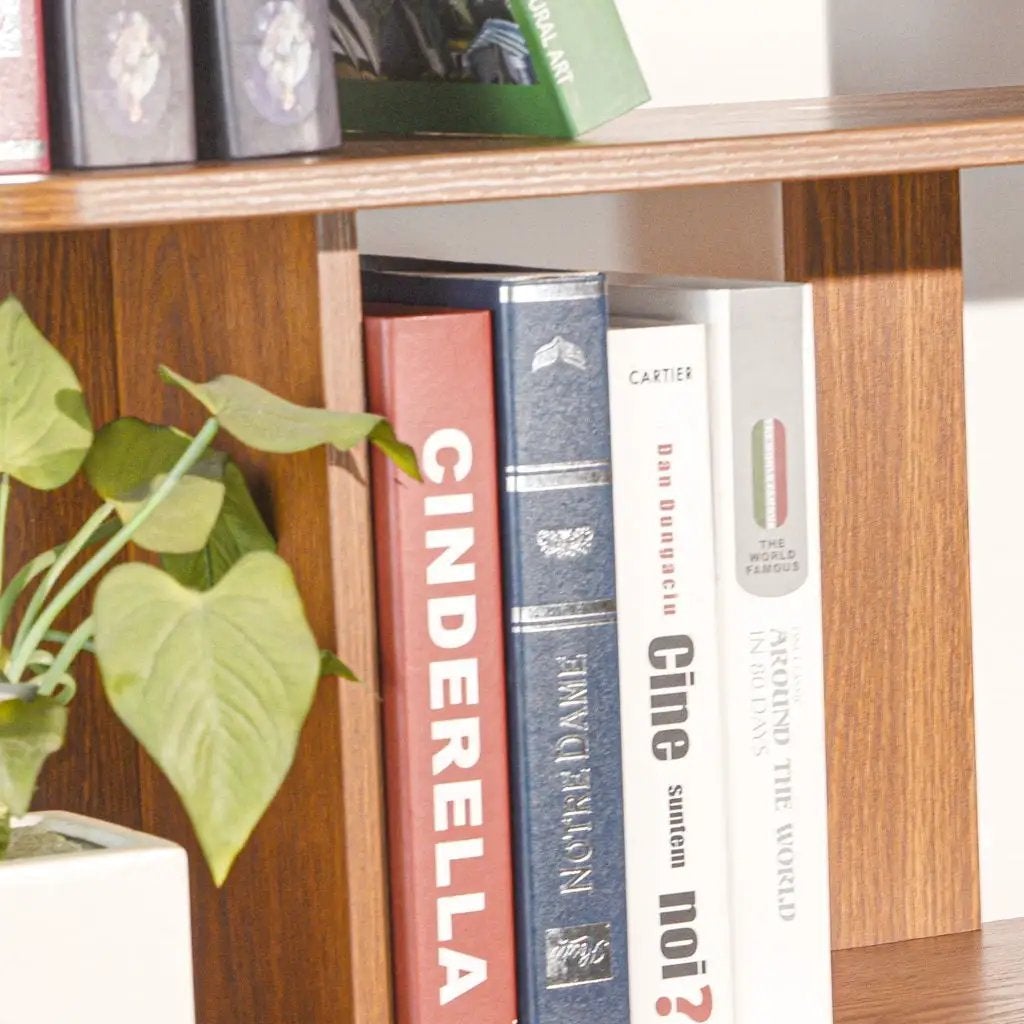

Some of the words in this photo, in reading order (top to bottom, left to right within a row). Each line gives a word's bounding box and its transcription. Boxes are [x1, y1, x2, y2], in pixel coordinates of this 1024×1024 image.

[546, 50, 575, 85] ART
[628, 366, 695, 386] CARTIER
[656, 443, 674, 488] Dan
[745, 561, 801, 576] FAMOUS
[749, 549, 797, 563] WORLD
[758, 538, 785, 550] THE
[749, 630, 764, 656] IN
[648, 633, 696, 762] Cine
[751, 663, 765, 689] 80
[769, 628, 791, 747] AROUND
[422, 427, 488, 1006] CINDERELLA
[554, 653, 590, 762] DAME
[751, 698, 769, 758] DAYS
[774, 758, 793, 812] THE
[559, 768, 593, 895] NOTRE
[668, 784, 686, 869] suntem
[776, 823, 796, 923] WORLD
[655, 890, 713, 1023] noi?
